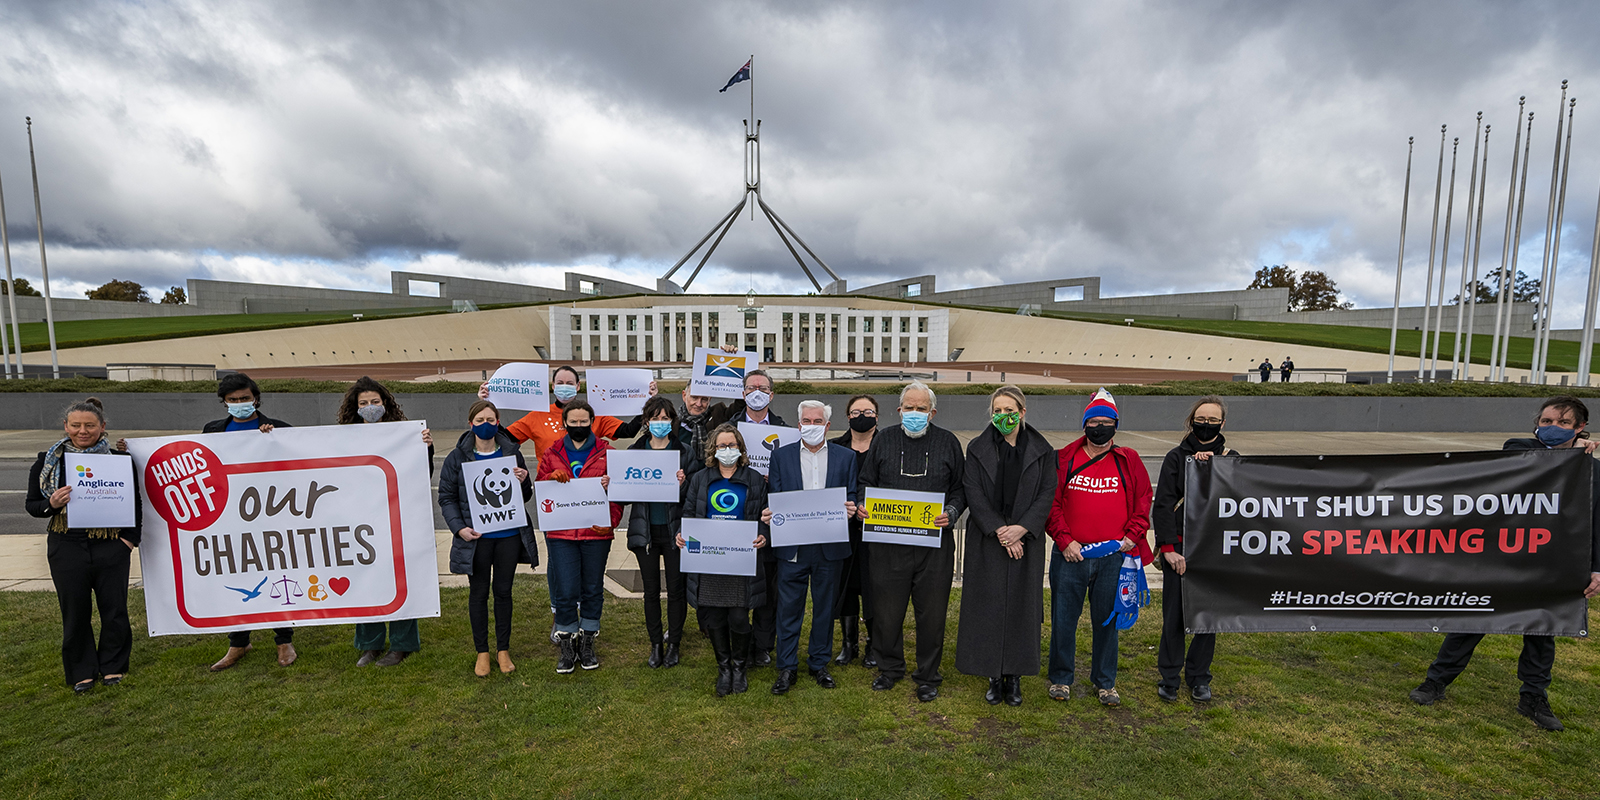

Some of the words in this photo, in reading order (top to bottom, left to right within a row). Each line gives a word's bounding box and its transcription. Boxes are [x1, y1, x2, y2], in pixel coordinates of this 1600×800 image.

[488, 385, 530, 394] AUSTRALIA
[151, 448, 208, 486] HANDS
[624, 466, 662, 481] fare
[78, 480, 124, 488] Anglicare
[1069, 475, 1118, 488] RESULTS
[164, 470, 216, 522] OFF
[240, 480, 339, 522] our
[873, 503, 913, 514] AMNESTY
[1218, 497, 1308, 518] DON'T
[1316, 496, 1395, 517] SHUT
[1403, 494, 1443, 516] US
[1453, 493, 1559, 516] DOWN
[479, 509, 516, 524] WWF
[872, 514, 912, 522] INTERNATIONAL
[1222, 530, 1292, 555] FOR
[1302, 528, 1484, 555] SPEAKING
[1498, 528, 1552, 554] UP
[193, 524, 376, 576] CHARITIES
[1270, 591, 1491, 605] #HandsOffCharities
